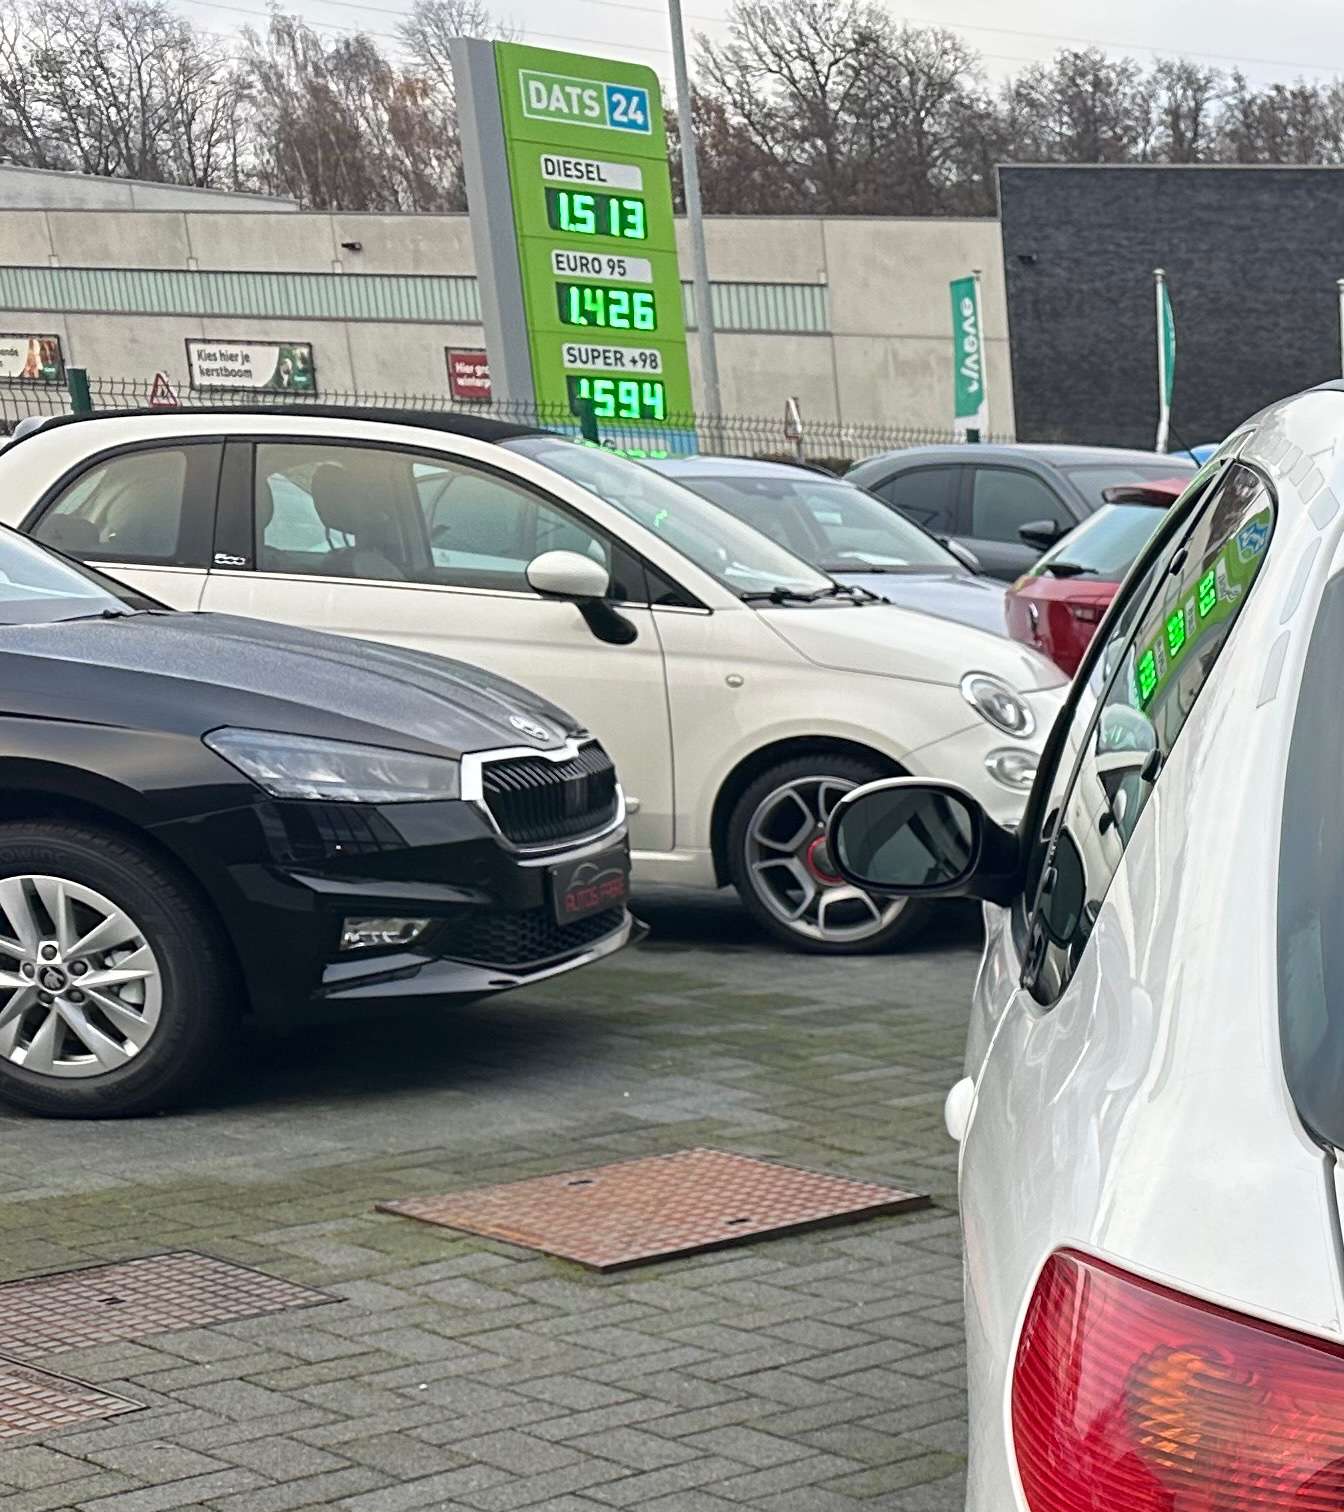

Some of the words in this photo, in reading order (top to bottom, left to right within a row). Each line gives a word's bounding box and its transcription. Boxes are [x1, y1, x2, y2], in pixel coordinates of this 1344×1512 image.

[528, 80, 600, 118] DATS
[611, 93, 645, 126] 24
[544, 157, 608, 183] DIESEL
[555, 253, 602, 274] EURO
[607, 258, 626, 276] 95
[566, 346, 625, 367] SUPER
[629, 352, 658, 369] +98
[199, 365, 253, 379] kerstboom
[214, 552, 246, 566] 500
